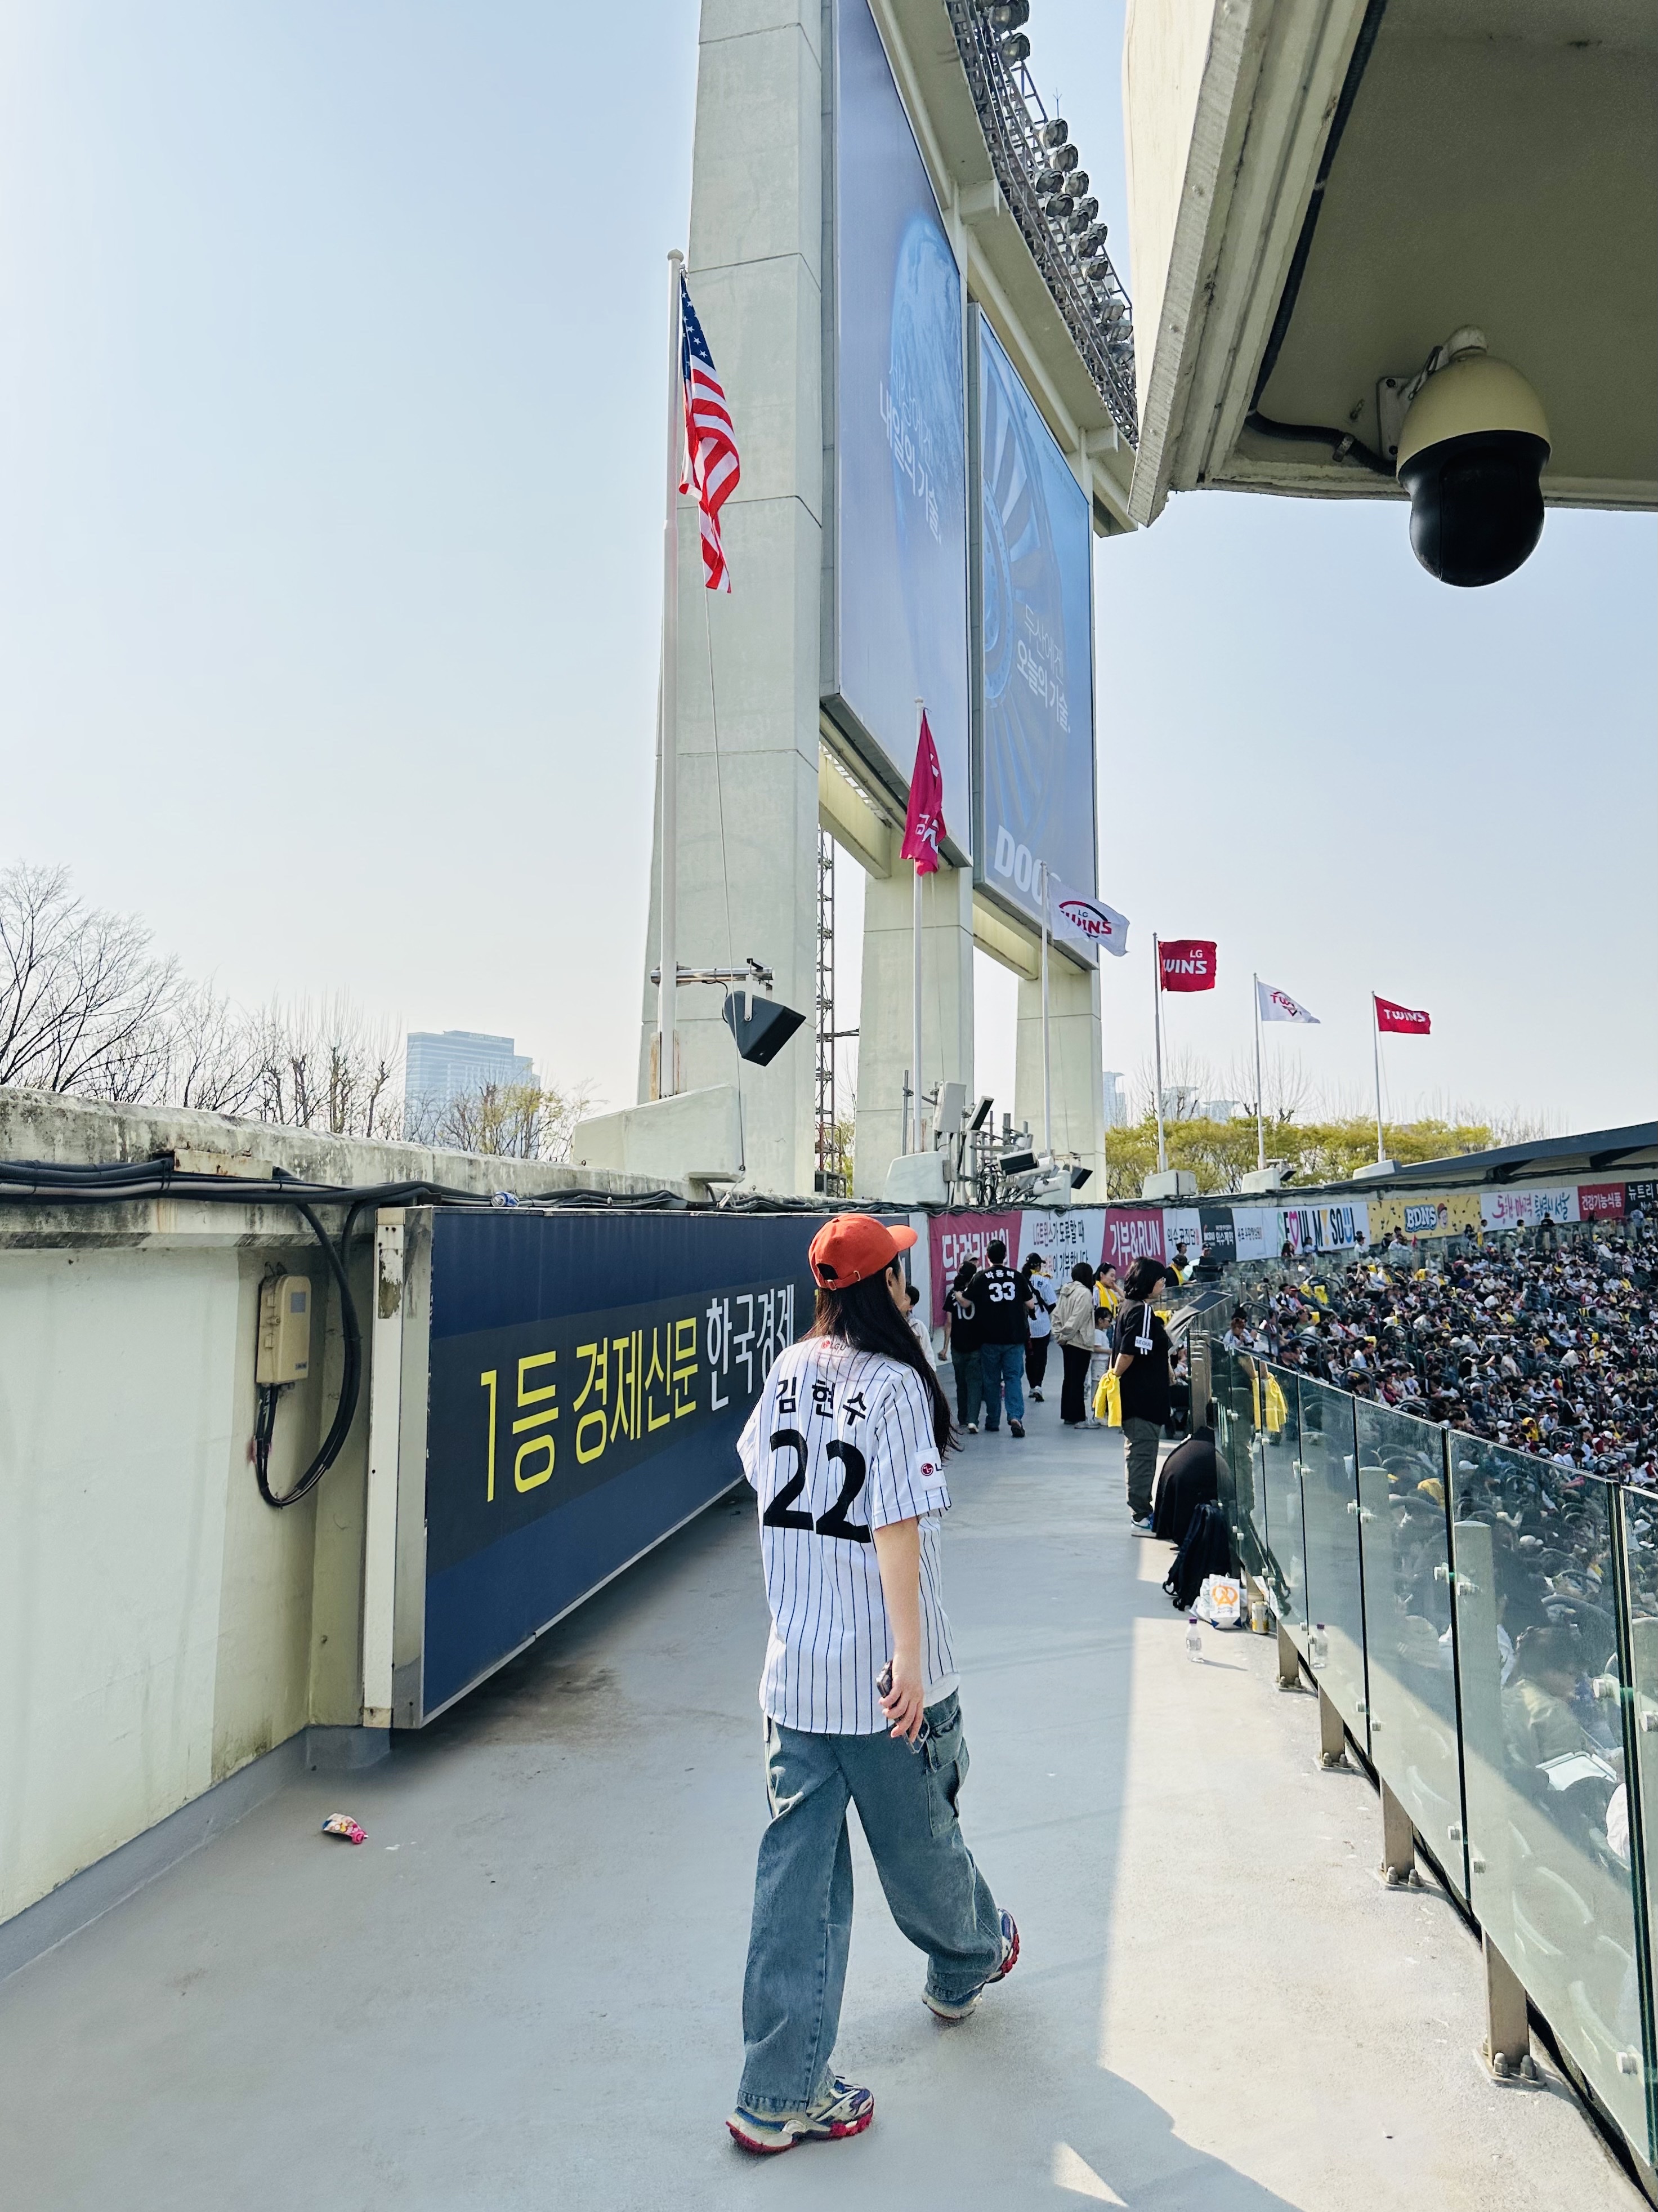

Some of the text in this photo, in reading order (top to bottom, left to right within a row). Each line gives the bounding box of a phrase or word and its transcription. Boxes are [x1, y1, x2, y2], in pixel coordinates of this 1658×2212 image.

[880, 380, 916, 496] 내일의
[1024, 604, 1063, 685] 두산에겐
[1017, 639, 1070, 734] 오늘의 기술.
[1078, 909, 1089, 918] LG
[1190, 949, 1203, 958] LG
[1383, 1009, 1426, 1023] TWINS
[1555, 1192, 1570, 1220] 서울
[1581, 1192, 1623, 1211] 건강기능식품
[1330, 1207, 1356, 1245] SOUL
[1406, 1206, 1437, 1229] BDNS
[1060, 1220, 1076, 1246] 도루할
[1078, 1219, 1084, 1243] 때
[989, 1282, 1016, 1302] 33
[480, 1284, 796, 1503] 1등 경제신문 한국경제
[776, 1376, 866, 1425] 김현수
[763, 1428, 872, 1544] 22
